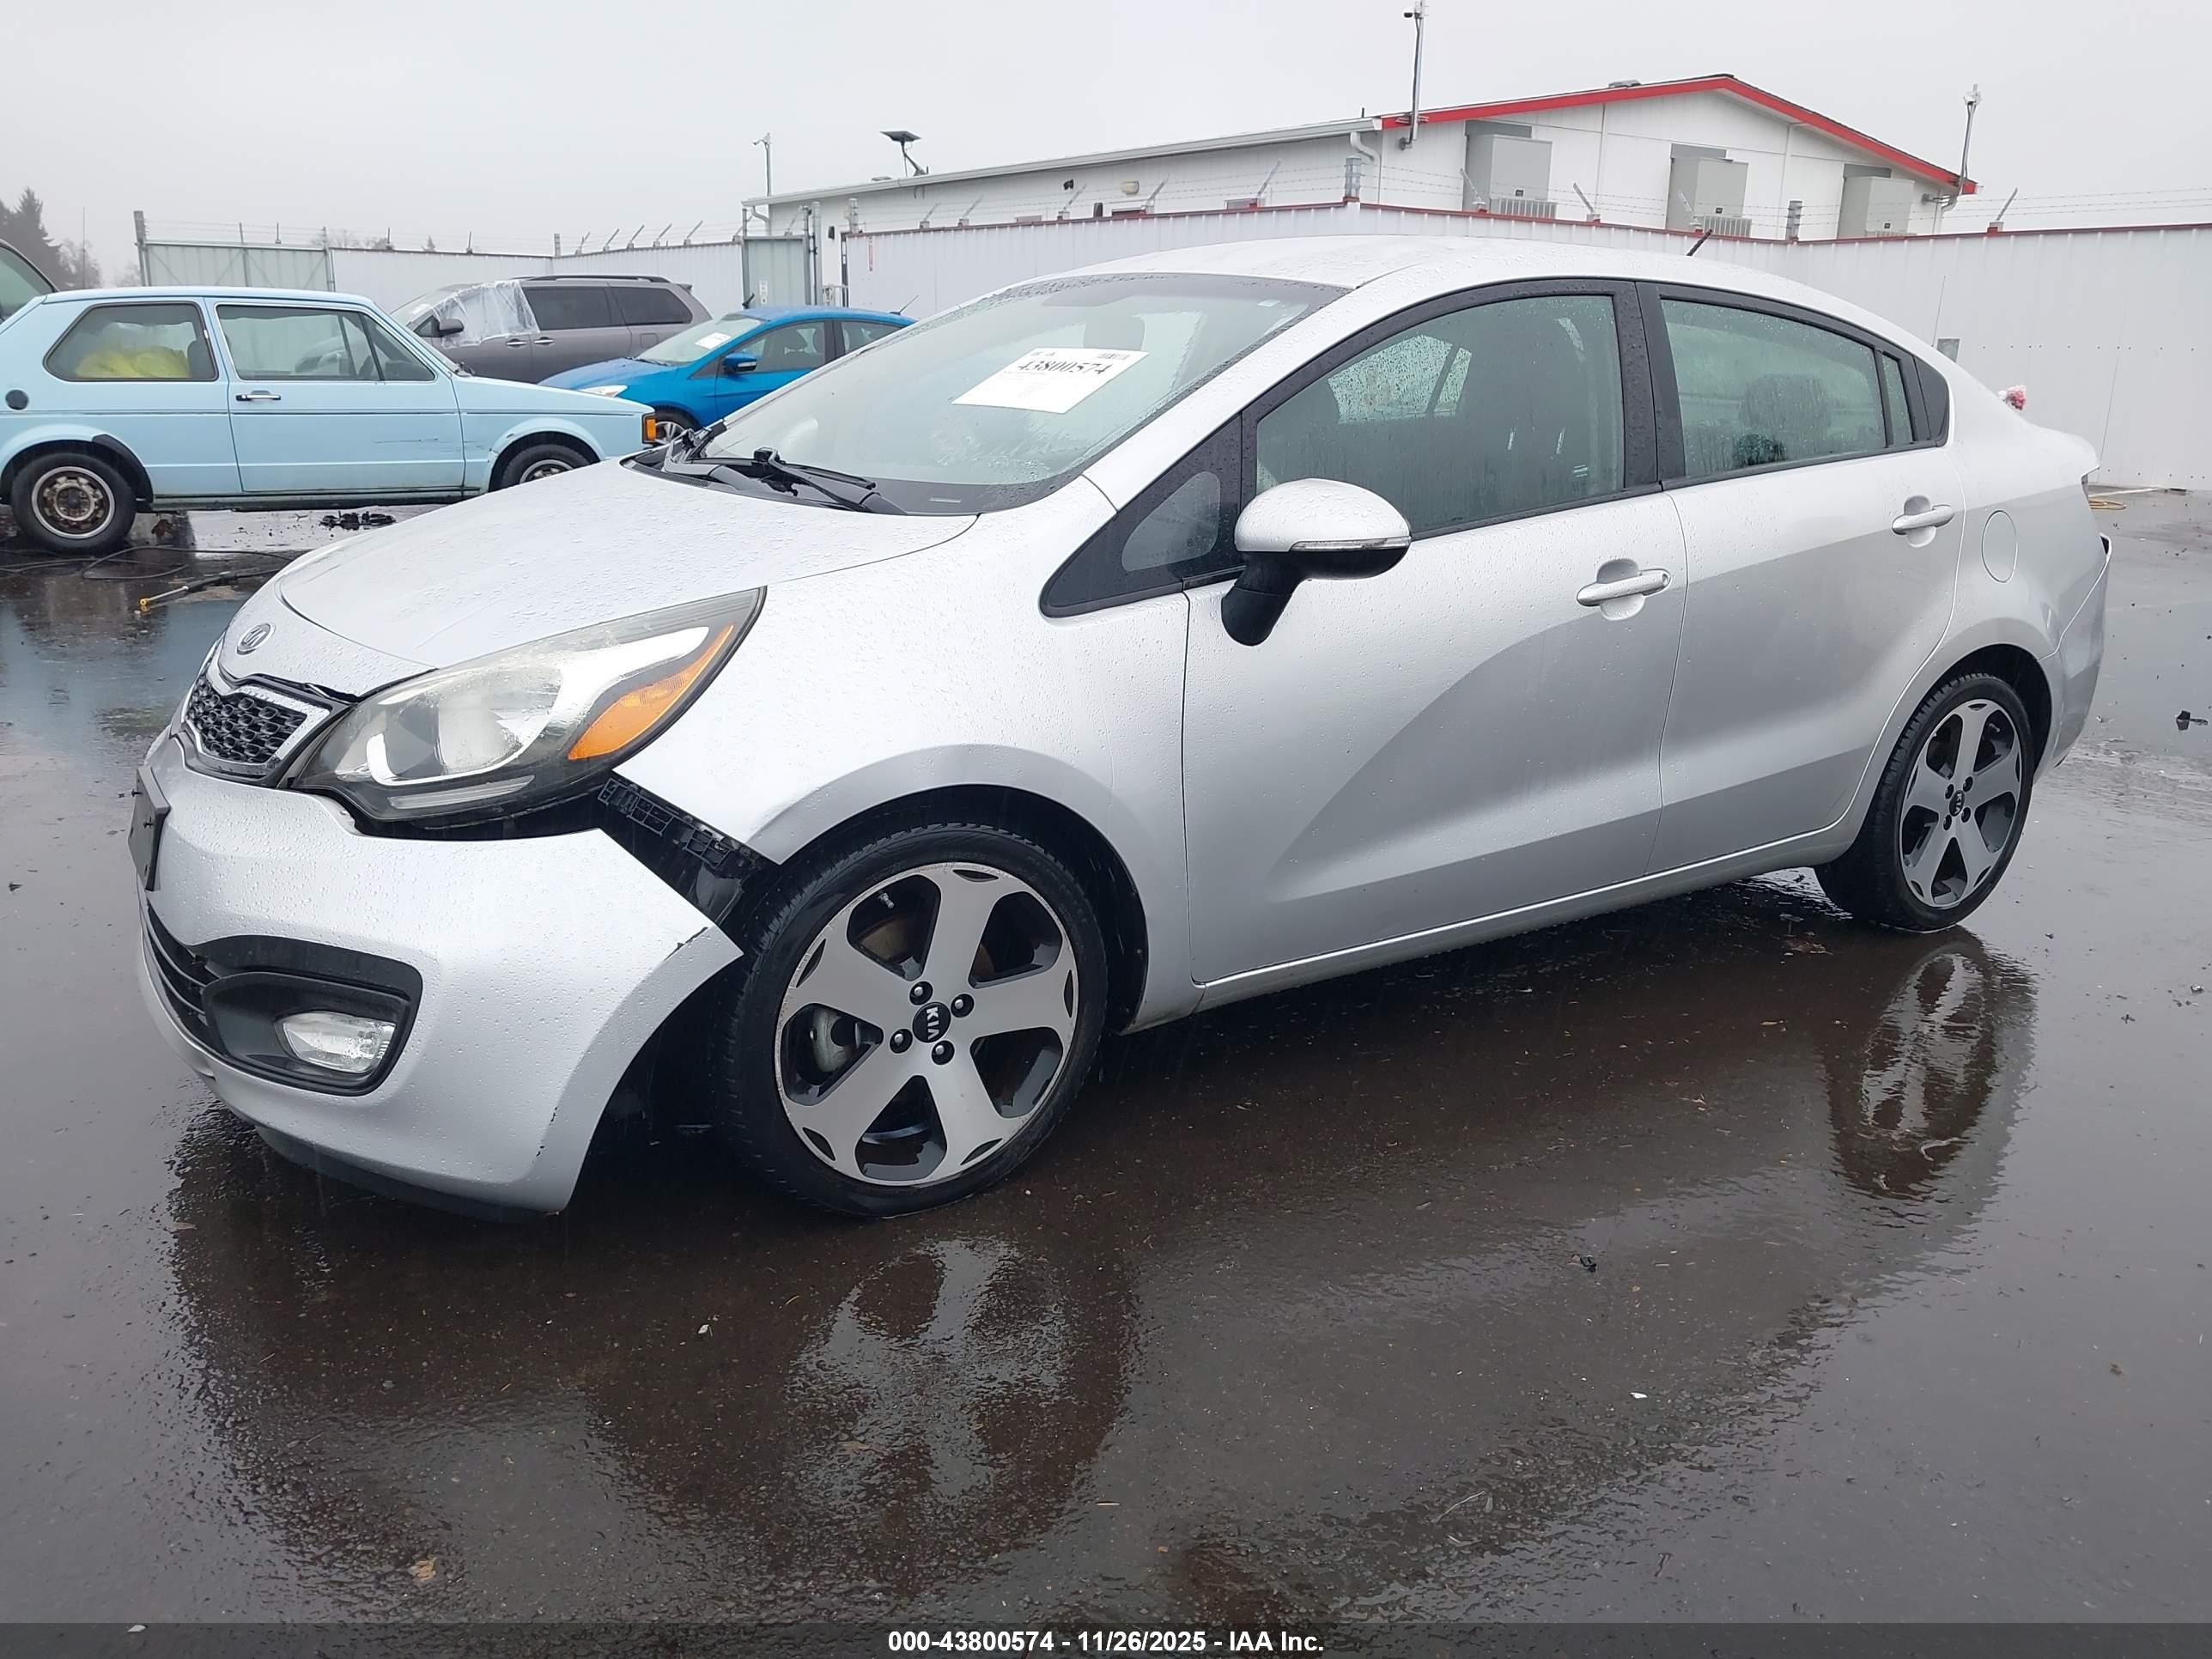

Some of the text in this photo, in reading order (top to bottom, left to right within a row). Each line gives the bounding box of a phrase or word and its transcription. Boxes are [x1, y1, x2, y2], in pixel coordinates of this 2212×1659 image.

[1018, 359, 1113, 375] 43800574
[1954, 793, 1963, 814] KIA
[926, 1006, 940, 1041] KIA
